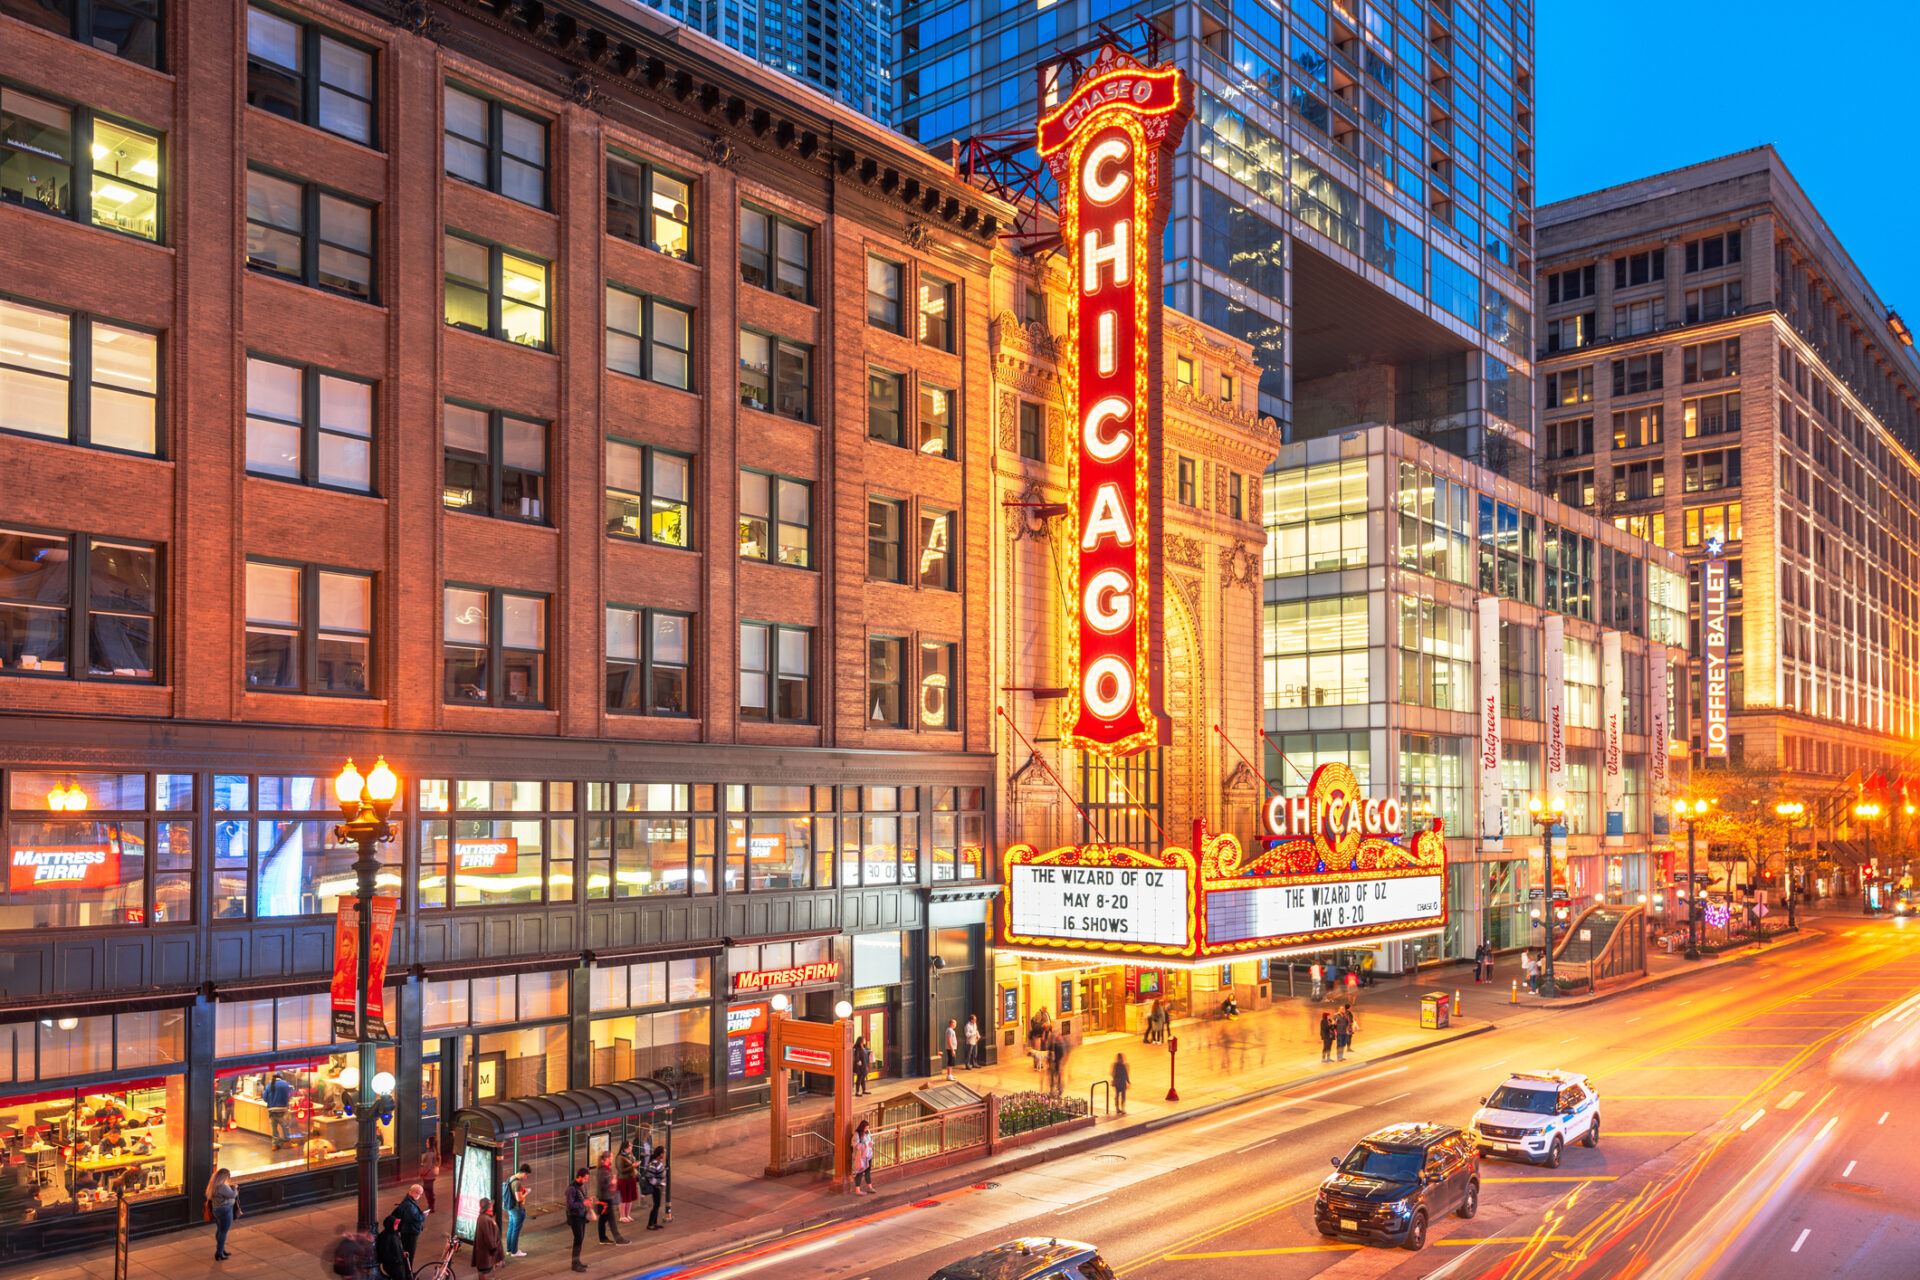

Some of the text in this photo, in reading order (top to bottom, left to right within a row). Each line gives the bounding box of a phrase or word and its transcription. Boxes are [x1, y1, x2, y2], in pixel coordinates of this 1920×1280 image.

[1063, 79, 1131, 130] CHASE
[1081, 139, 1132, 722] CHICAGO
[1708, 564, 1726, 754] JOFFREY BALLET
[1484, 695, 1501, 771] Walgreens
[1549, 704, 1565, 774] Walgreens
[1607, 713, 1622, 777] Walgreens
[1654, 721, 1668, 781] Walgreens
[1268, 795, 1401, 835] CHICAGO
[13, 851, 105, 866] MATTRESS
[34, 864, 87, 881] FIRM
[460, 854, 496, 867] FIRM
[1031, 868, 1164, 888] THE WIZARD OF OZ
[1063, 892, 1128, 910] MAY 8-20
[1286, 882, 1387, 909] THE WIZARD OF OZ
[1063, 915, 1128, 933] 16 SHOWS
[1313, 905, 1364, 928] MAY 8-20
